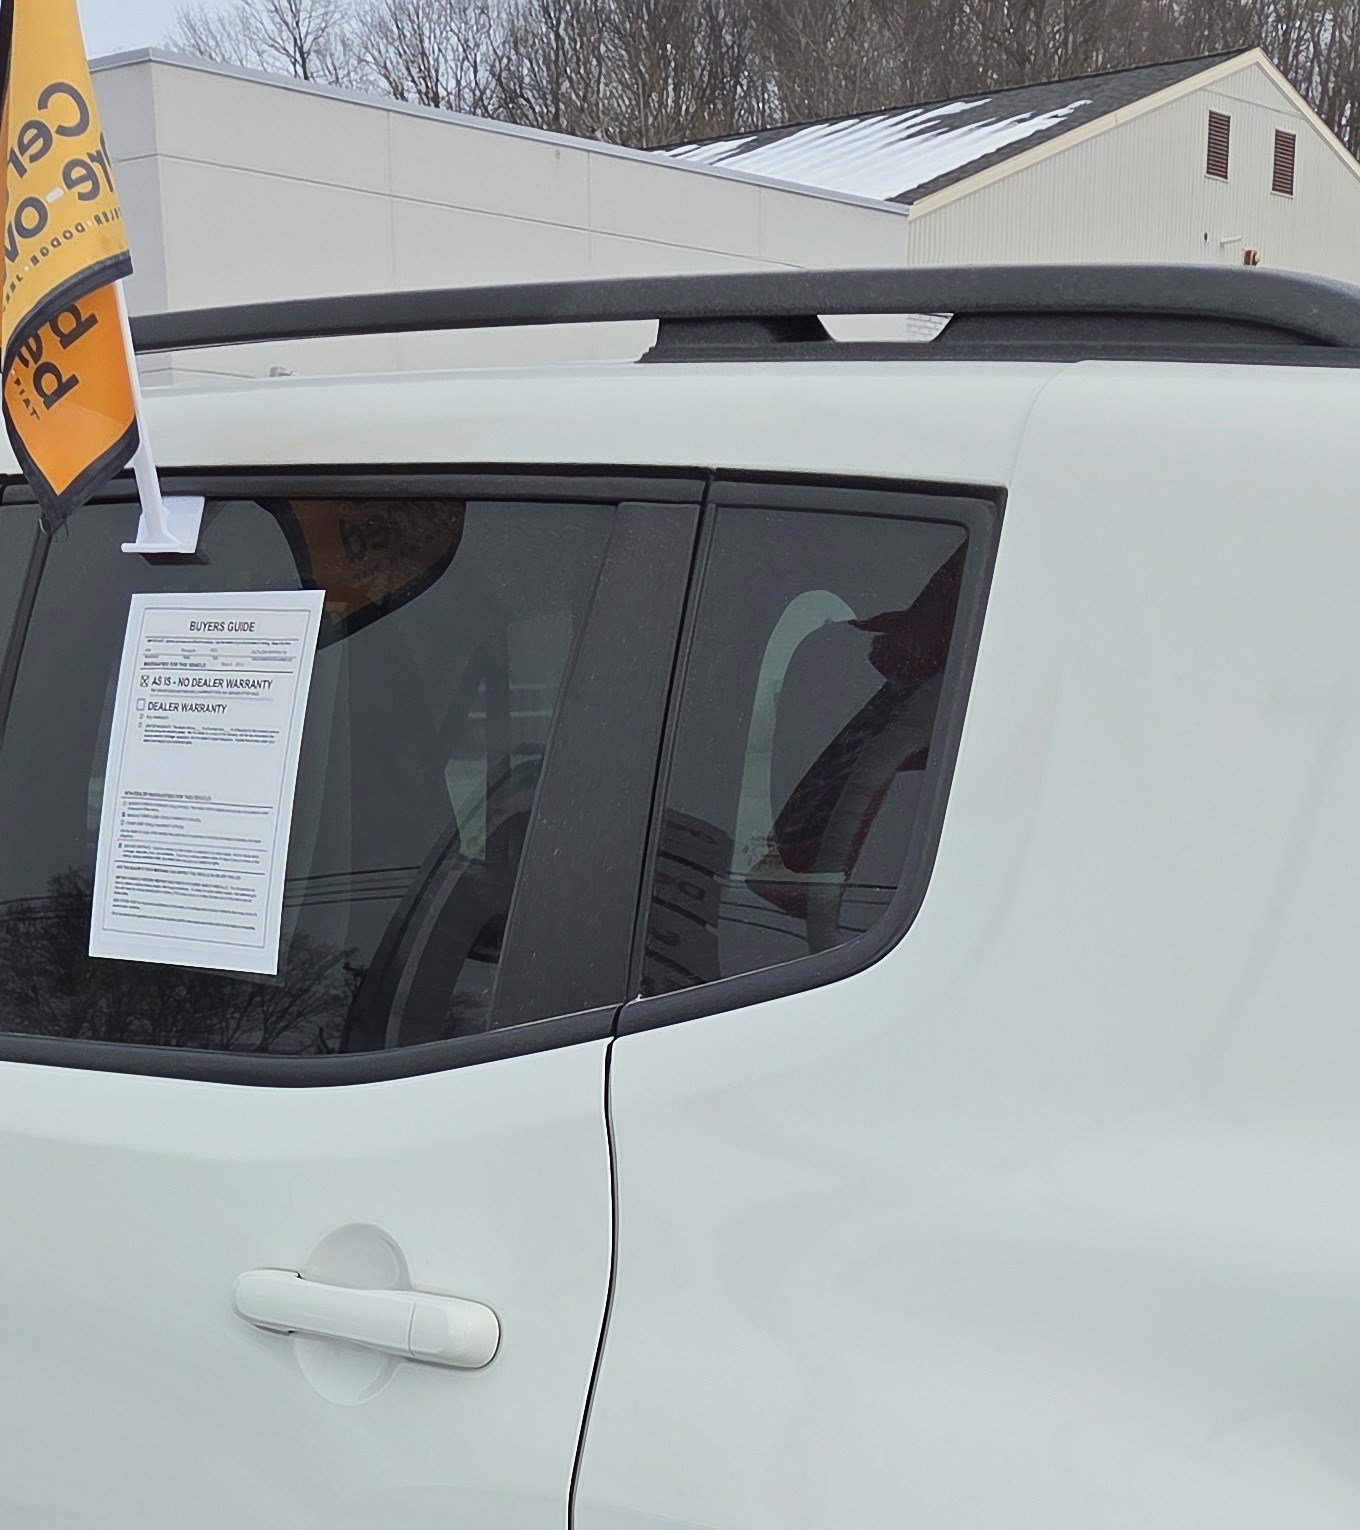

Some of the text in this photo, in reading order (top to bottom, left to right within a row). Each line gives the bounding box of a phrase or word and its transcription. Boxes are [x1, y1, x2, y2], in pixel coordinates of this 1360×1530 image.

[189, 620, 255, 632] BUYERS GUIDE
[151, 676, 162, 686] AS
[163, 677, 172, 686] IS
[177, 677, 190, 687] NO
[191, 678, 224, 689] DEALER
[225, 679, 273, 690] WARRANTY
[147, 701, 228, 714] DEALER WARRANTY
